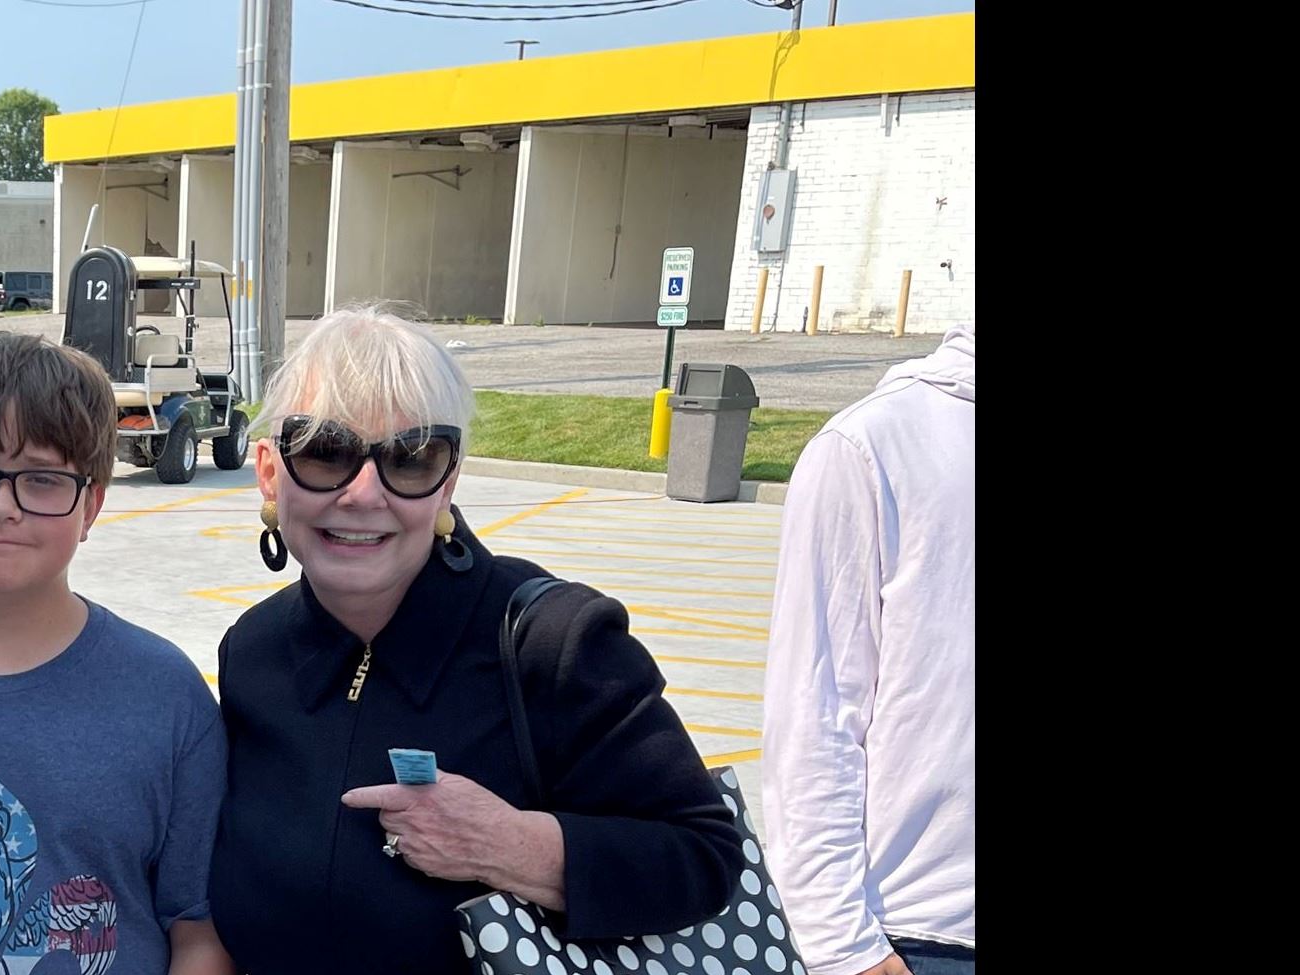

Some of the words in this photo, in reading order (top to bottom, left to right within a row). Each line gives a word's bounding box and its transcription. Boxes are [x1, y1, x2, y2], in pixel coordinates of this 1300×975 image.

[667, 263, 688, 271] PARKING
[86, 280, 108, 300] 12
[661, 311, 673, 320] $250
[674, 311, 684, 320] FINE
